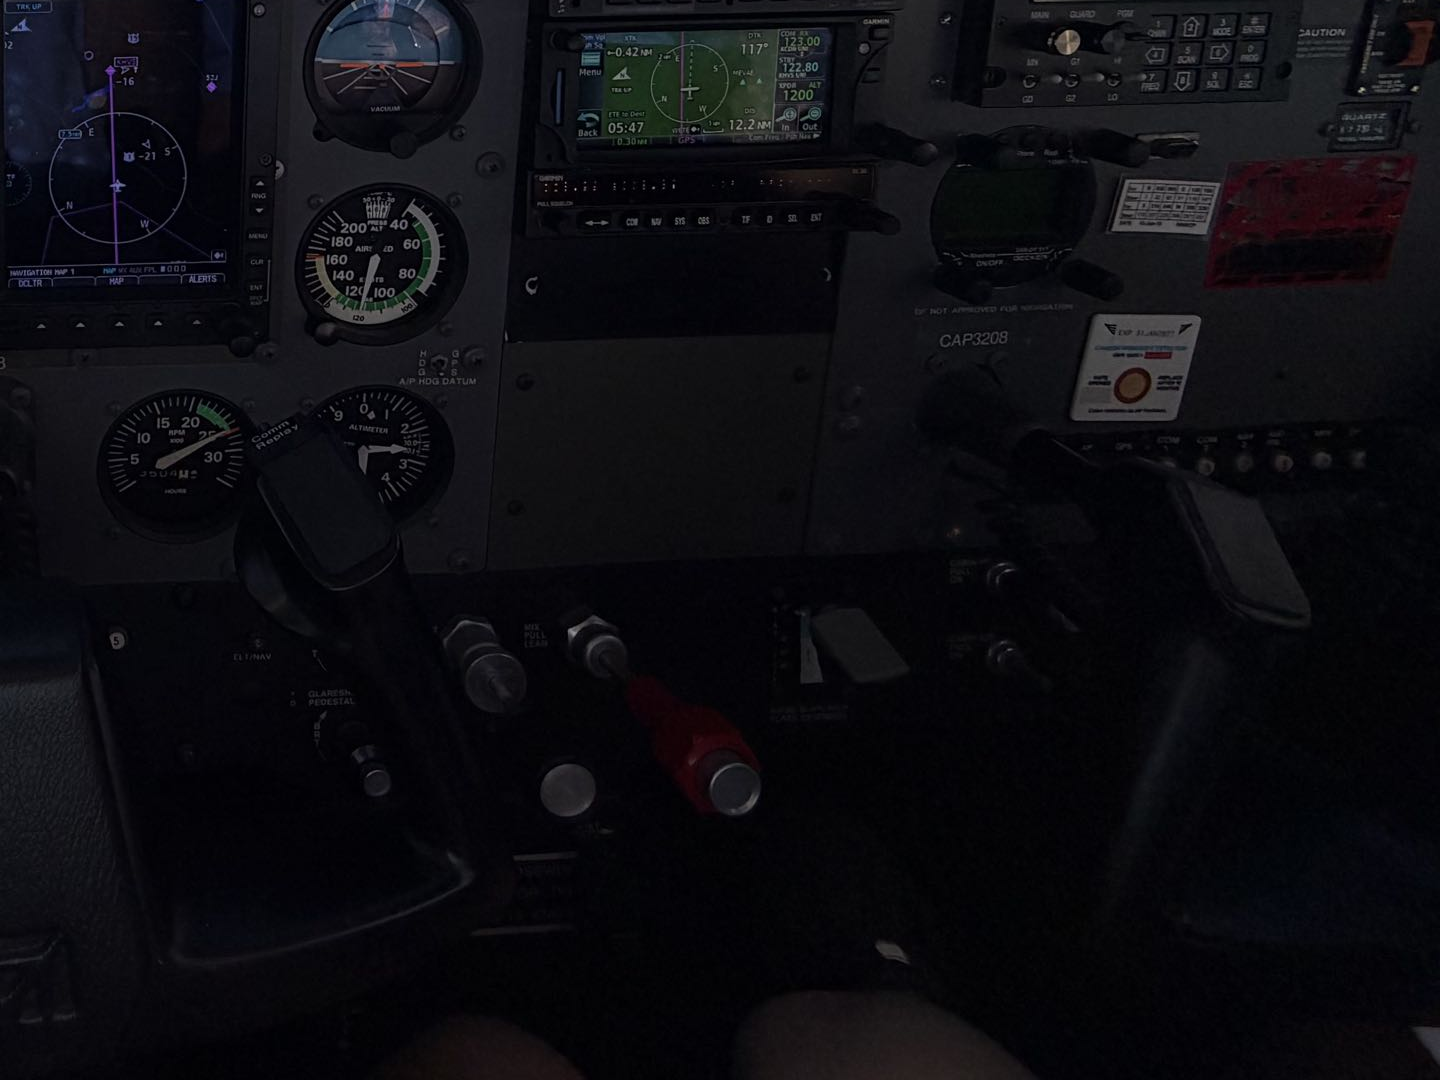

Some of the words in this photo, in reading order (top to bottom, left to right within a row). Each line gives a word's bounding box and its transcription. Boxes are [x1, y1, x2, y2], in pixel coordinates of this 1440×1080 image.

[785, 37, 820, 46] 123.00
[615, 47, 639, 57] 0.42
[742, 43, 768, 55] 117°
[579, 68, 602, 76] Menu
[783, 62, 819, 72] 122.80
[784, 90, 813, 101] 1200
[608, 122, 644, 133] 05:47
[730, 119, 754, 130] 12.2
[578, 129, 598, 137] Back
[340, 223, 367, 234] 200
[389, 219, 408, 230] 40
[331, 236, 353, 247] 180
[403, 239, 421, 250] 60
[326, 254, 348, 265] 160
[189, 275, 217, 283] ALERTS
[333, 270, 354, 281] 140
[398, 269, 416, 279] 80
[18, 280, 42, 288] DCLTR
[374, 288, 395, 298] 100
[939, 331, 1008, 348] CAP3208
[156, 417, 170, 429] 15
[181, 417, 200, 428] 20
[250, 420, 290, 444] Comm
[349, 423, 389, 434] ALTIMETER
[137, 433, 151, 444] 10
[255, 424, 299, 450] Replay
[130, 454, 140, 464] 5
[204, 452, 223, 463] 30
